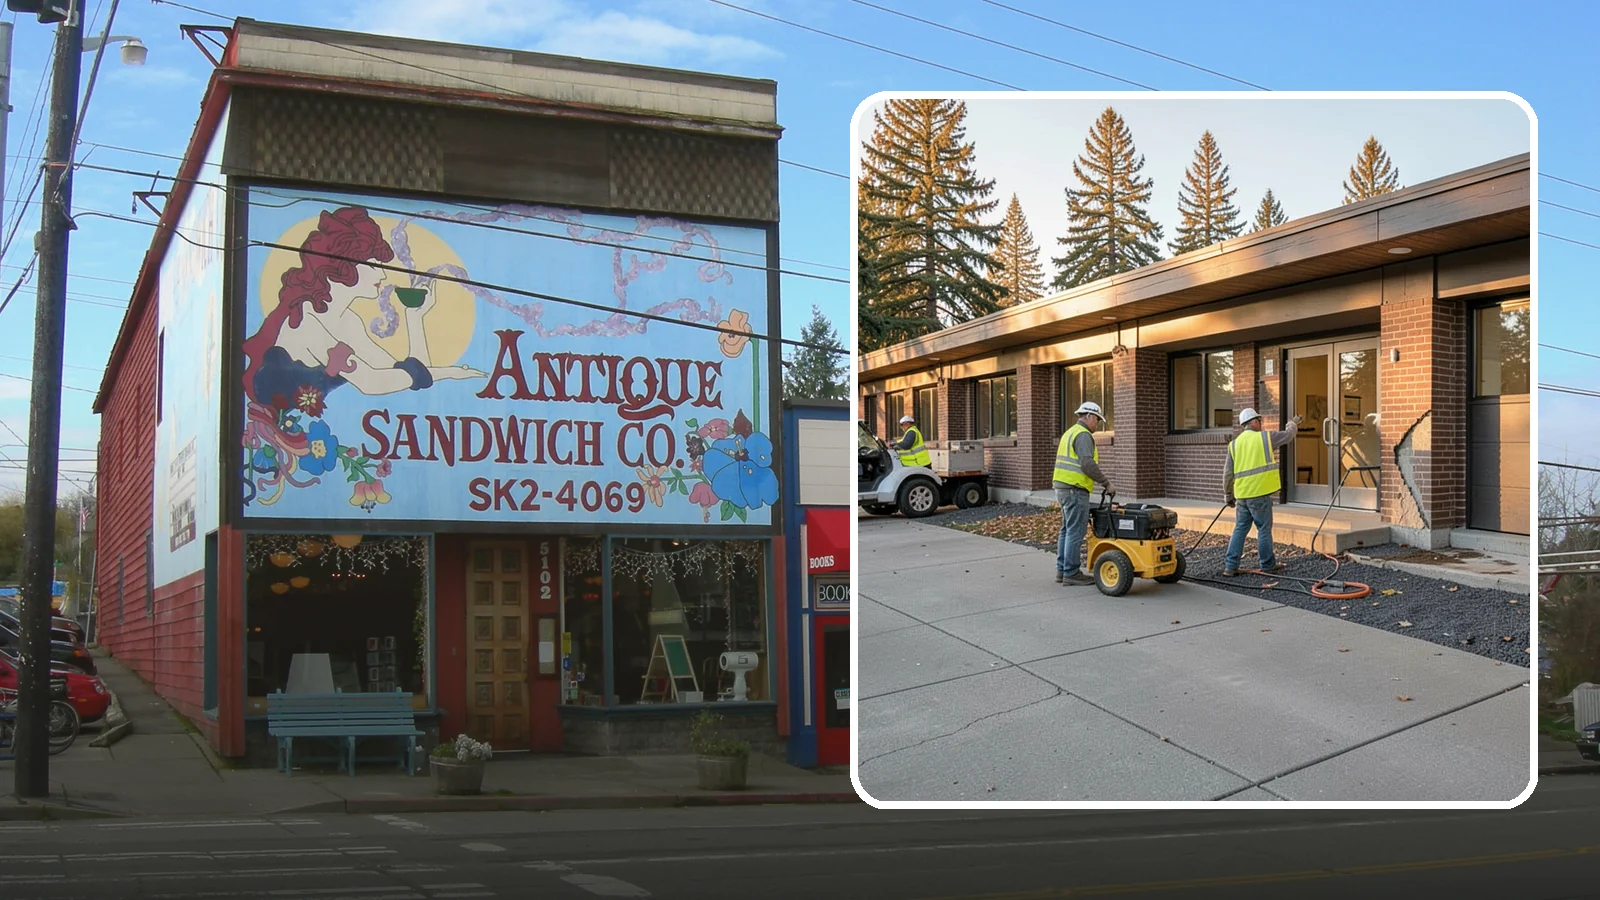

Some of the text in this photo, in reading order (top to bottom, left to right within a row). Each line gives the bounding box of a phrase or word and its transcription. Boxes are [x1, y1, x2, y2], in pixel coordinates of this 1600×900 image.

[476, 329, 723, 421] ANTIQUE
[360, 408, 685, 469] SANDWICH CO.
[468, 477, 646, 513] SK2-4069
[540, 541, 551, 600] 5102
[809, 555, 835, 569] BOOKS
